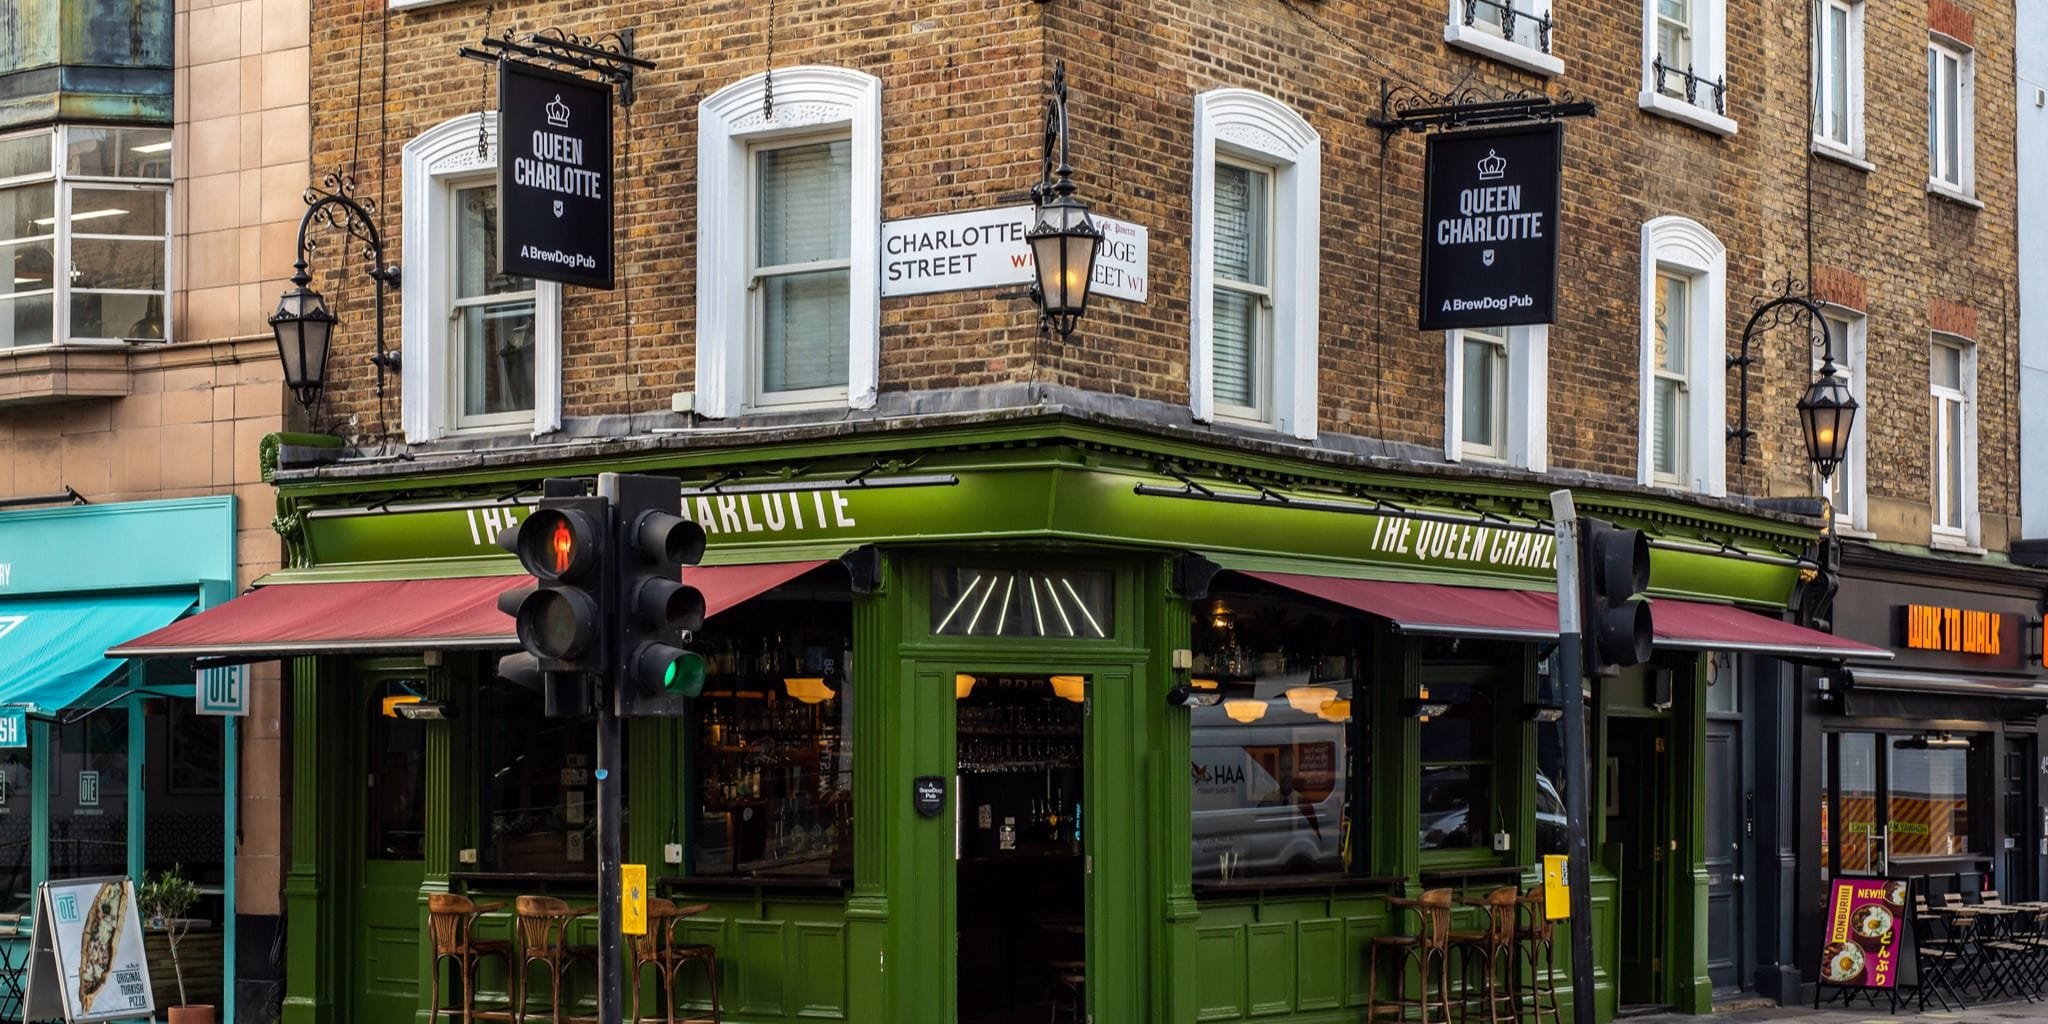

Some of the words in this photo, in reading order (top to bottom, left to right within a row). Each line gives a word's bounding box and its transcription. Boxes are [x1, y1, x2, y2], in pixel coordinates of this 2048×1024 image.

[532, 130, 583, 166] QUEEN
[514, 157, 601, 199] CHARLOTTE
[1460, 185, 1521, 216] QUEEN
[887, 221, 1023, 256] CHARLOTTE
[1115, 224, 1136, 237] Pancras
[1437, 212, 1543, 245] CHARLOTTE
[521, 245, 530, 258] A
[530, 247, 576, 267] BrewDog
[576, 253, 596, 269] Pub
[888, 254, 977, 281] STREET
[1091, 264, 1125, 288] EET
[1442, 299, 1452, 311] A
[1453, 296, 1508, 311] BrewDog
[1509, 294, 1533, 308] Pub
[1371, 515, 1411, 554] THE
[1415, 520, 1489, 561] QUEEN
[1489, 528, 1558, 570] CHARL
[1908, 604, 1942, 650] WOK
[1944, 607, 1961, 652] TO
[1963, 609, 2000, 655] WALK
[58, 896, 77, 920] OTE
[1876, 931, 1893, 986] どんぶり
[129, 995, 147, 1008] PIZZA
